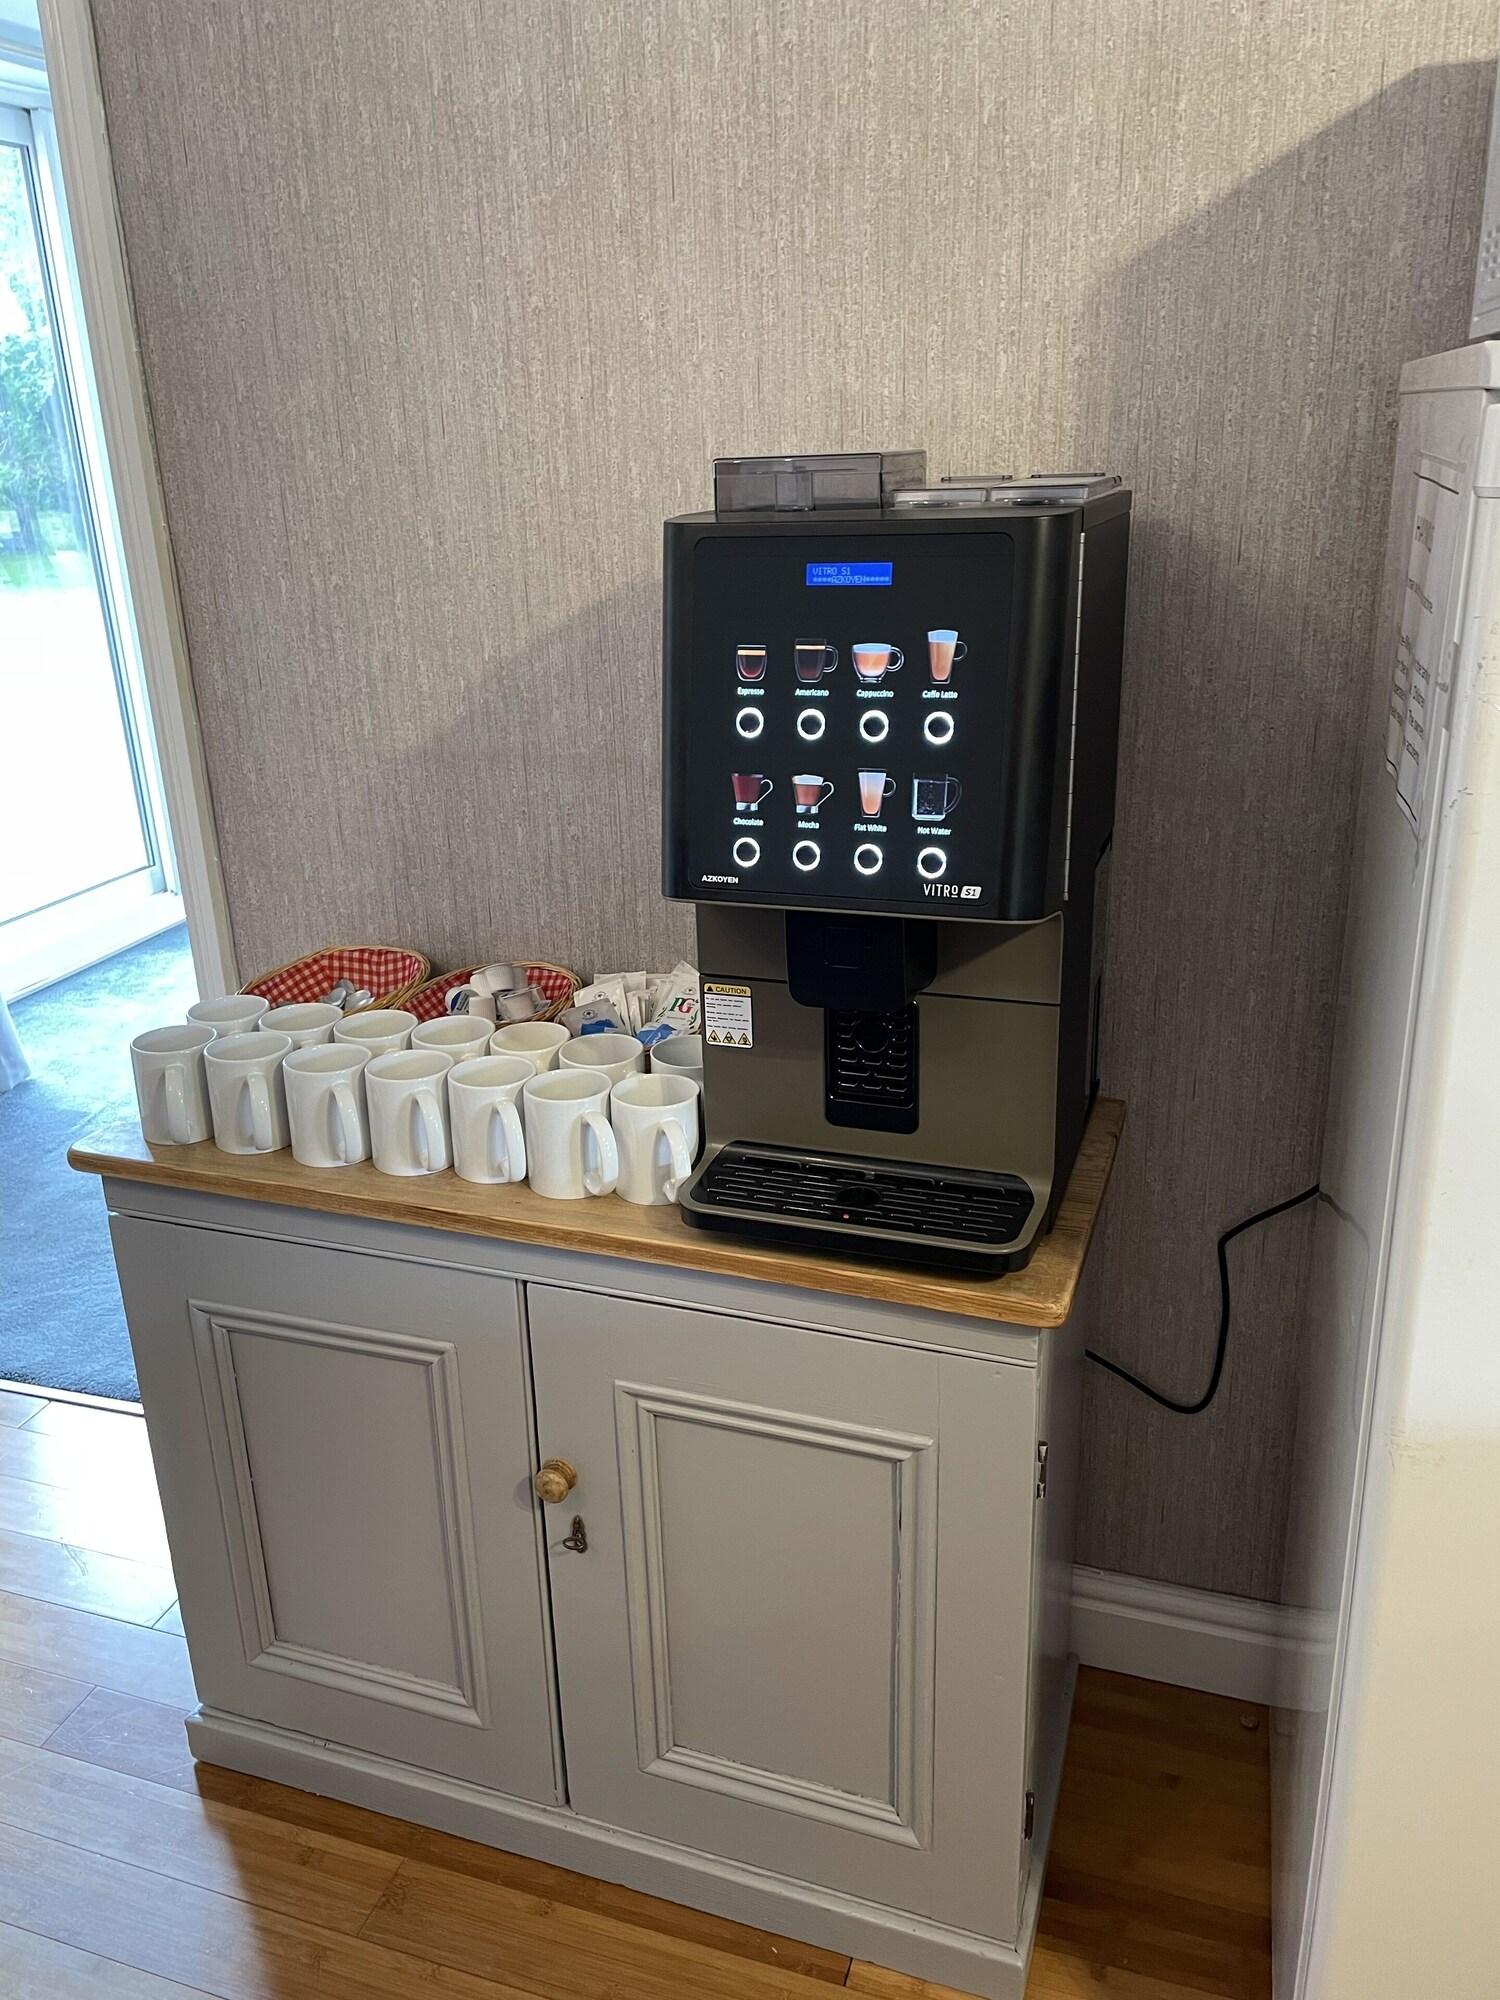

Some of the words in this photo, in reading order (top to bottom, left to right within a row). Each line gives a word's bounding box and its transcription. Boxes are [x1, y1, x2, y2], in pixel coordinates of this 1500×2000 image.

[812, 567, 838, 576] VITRO
[841, 566, 851, 576] S1
[737, 686, 765, 696] Espresso
[795, 687, 829, 697] Americano
[856, 689, 894, 698] Cappuccino
[941, 690, 958, 699] Latte
[733, 817, 764, 826] Chocolate
[797, 820, 819, 829] Mocha
[854, 823, 867, 832] Flat
[867, 823, 887, 833] White
[917, 826, 930, 834] Hot
[931, 826, 952, 836] Water
[701, 875, 739, 884] AZKOYEN
[923, 883, 959, 898] VITRO
[715, 986, 747, 995] CAUTION
[668, 997, 695, 1013] PG
